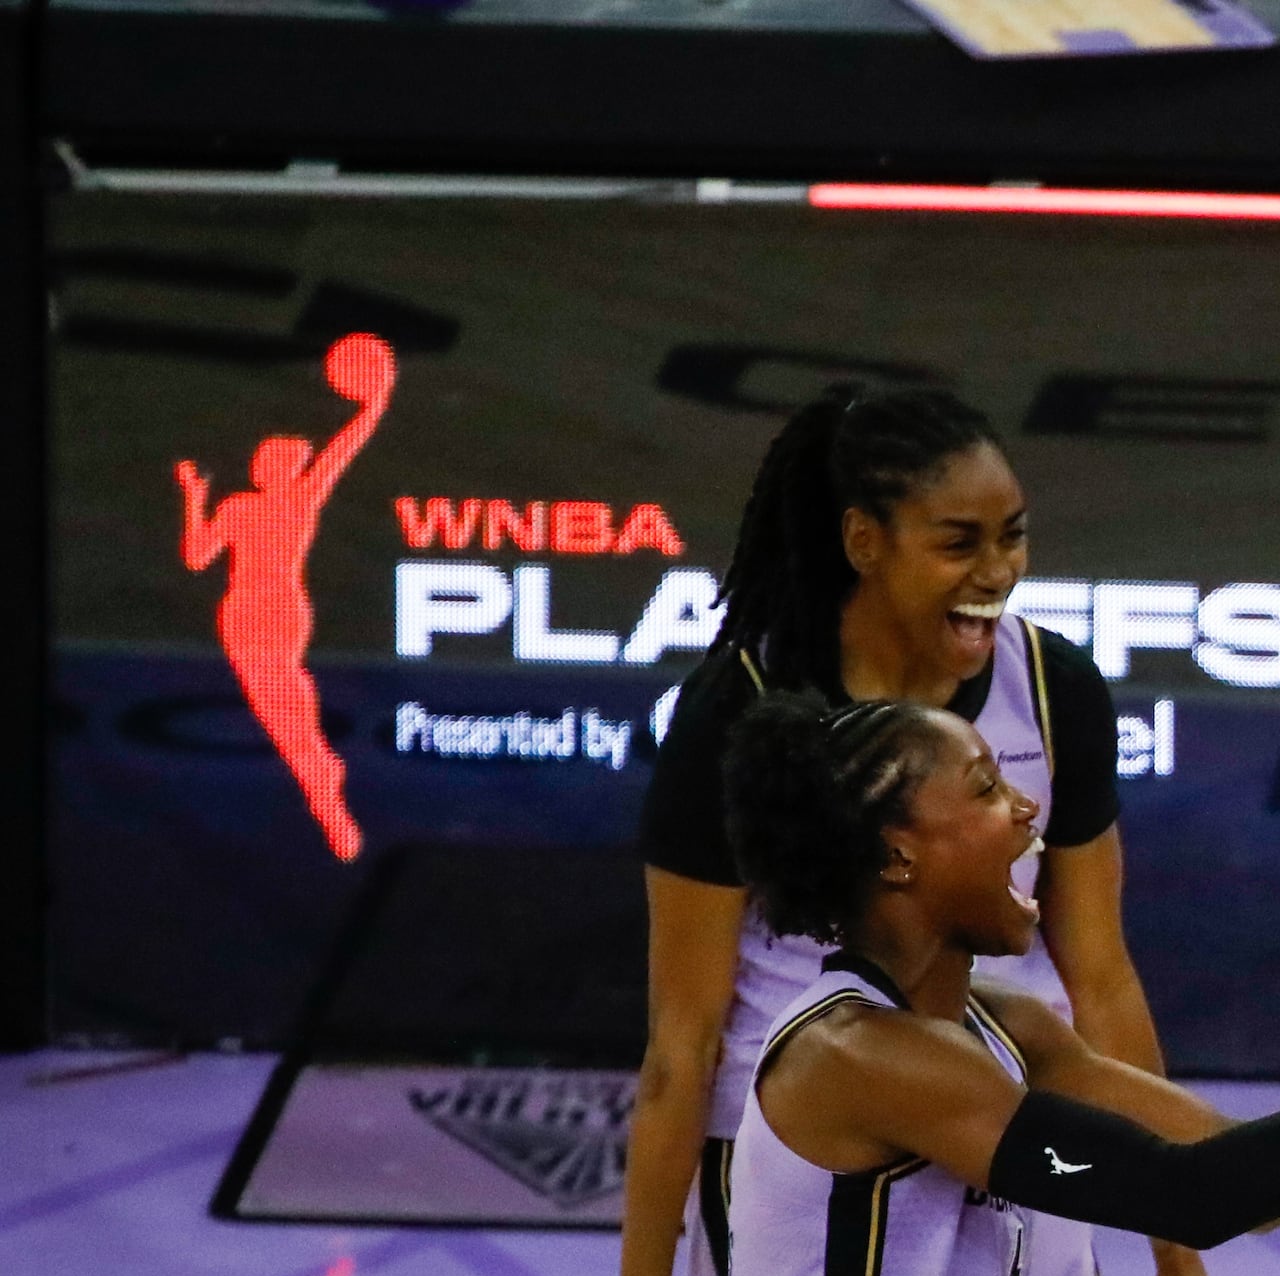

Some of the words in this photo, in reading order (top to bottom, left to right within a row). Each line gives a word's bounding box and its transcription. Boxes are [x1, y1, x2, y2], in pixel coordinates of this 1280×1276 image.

[395, 496, 687, 556] WNBA
[395, 701, 578, 758] Presented
[581, 706, 632, 771] by
